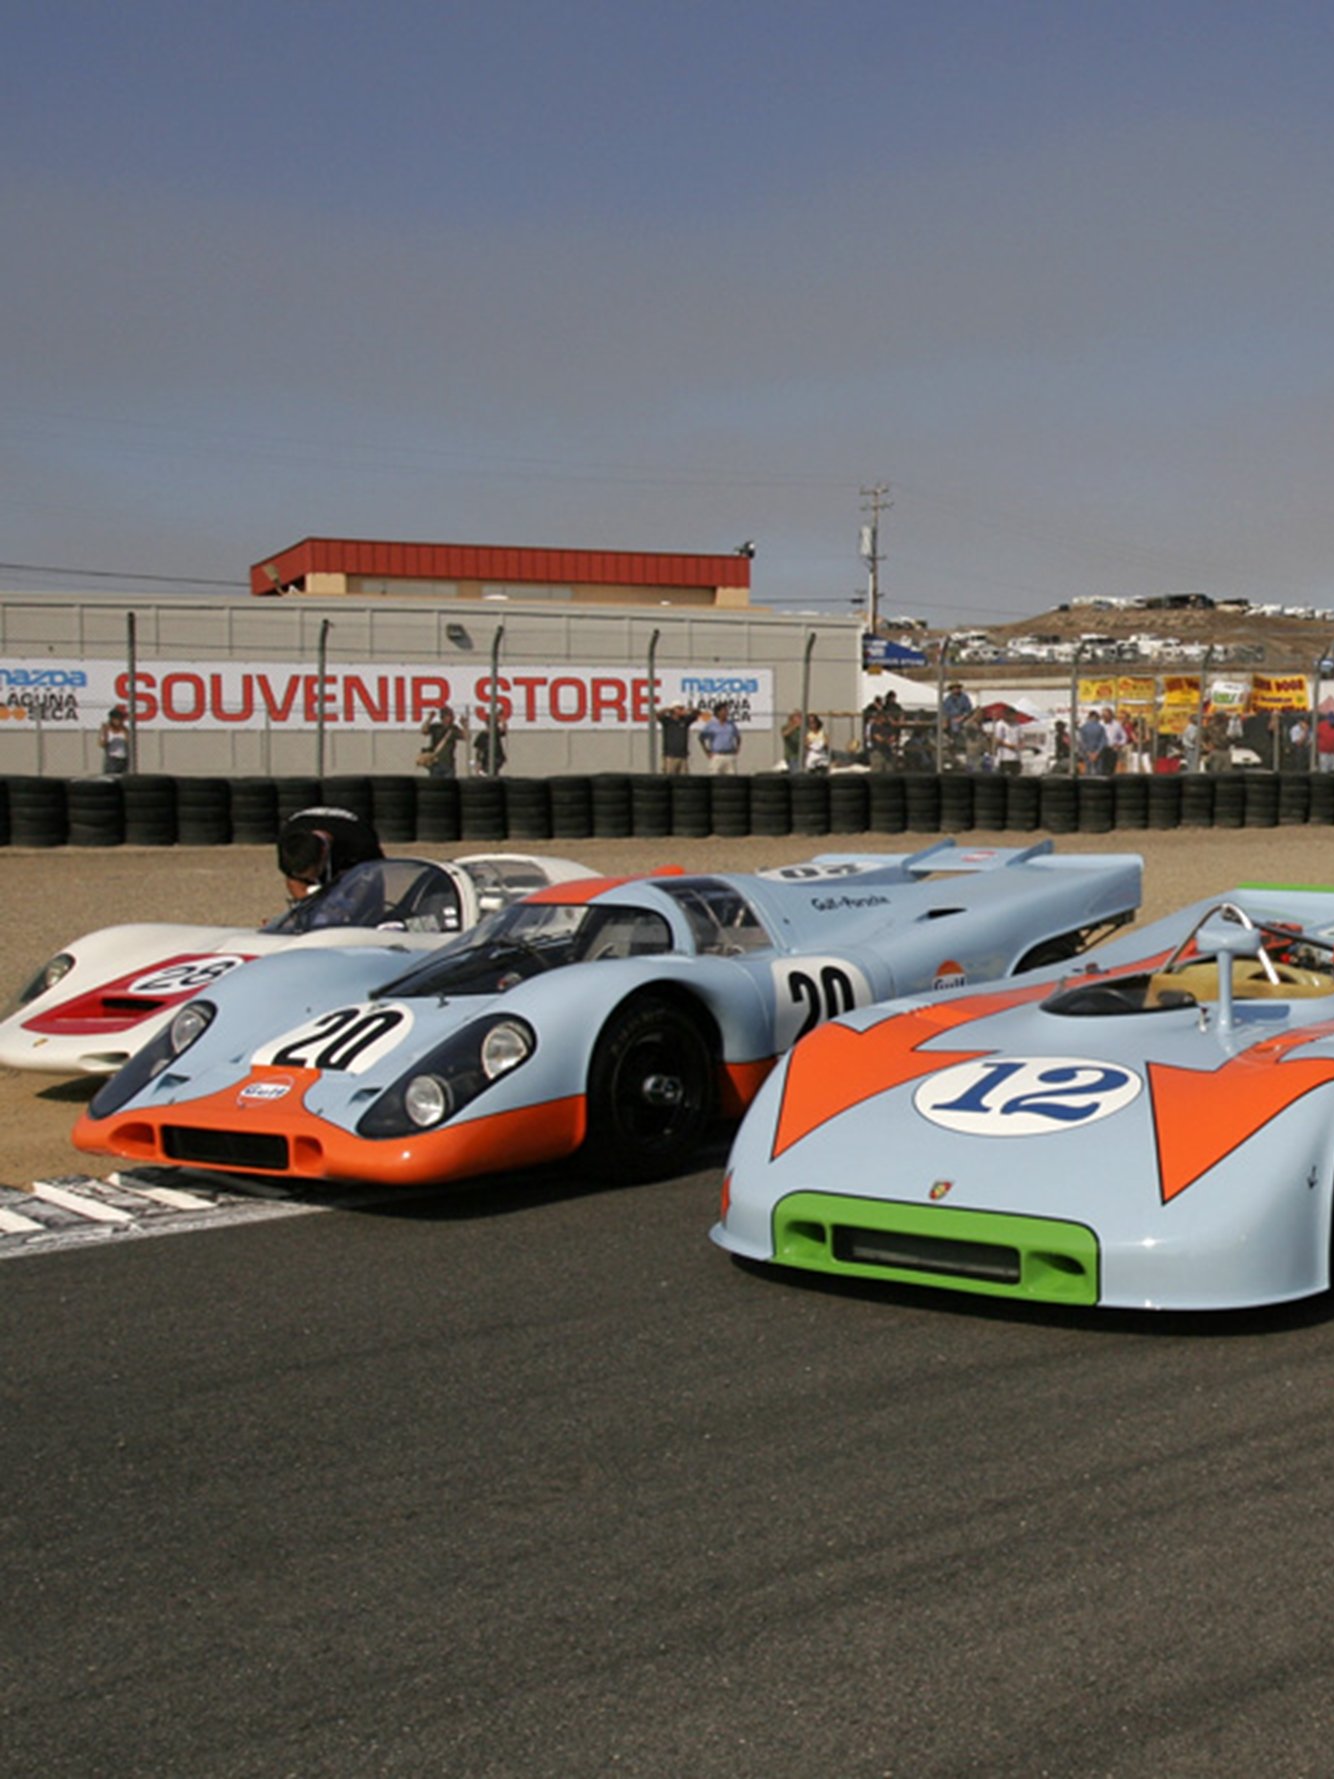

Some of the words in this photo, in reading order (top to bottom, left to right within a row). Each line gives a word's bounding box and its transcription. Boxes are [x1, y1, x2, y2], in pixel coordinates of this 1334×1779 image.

[0, 693, 79, 708] AGUNA
[114, 672, 451, 722] SOUVENIR
[474, 676, 662, 722] STORE
[682, 678, 758, 693] mazda
[688, 698, 751, 711] LAGNA
[136, 961, 236, 991] 28
[788, 966, 856, 1044] 20
[271, 1008, 404, 1072] 20
[931, 1062, 1130, 1122] 12
